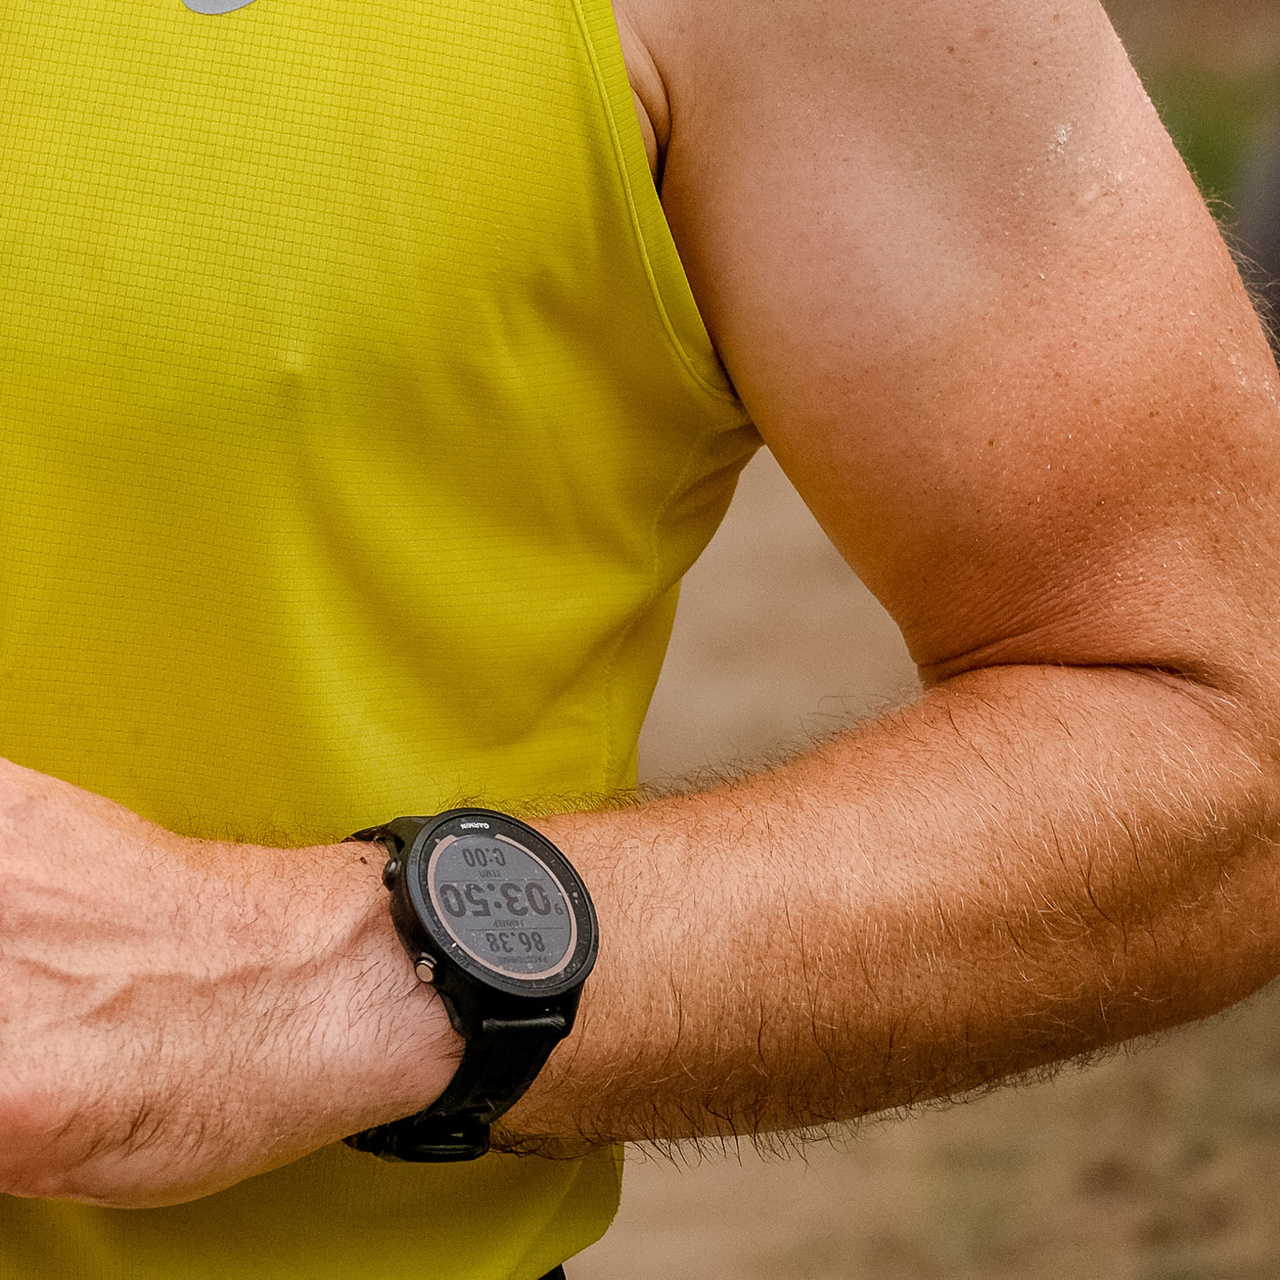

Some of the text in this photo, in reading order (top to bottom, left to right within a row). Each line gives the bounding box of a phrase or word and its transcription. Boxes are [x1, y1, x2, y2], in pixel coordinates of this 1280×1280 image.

[460, 822, 490, 830] GARMIN
[439, 882, 552, 918] 03:50
[485, 931, 546, 953] 86.38
